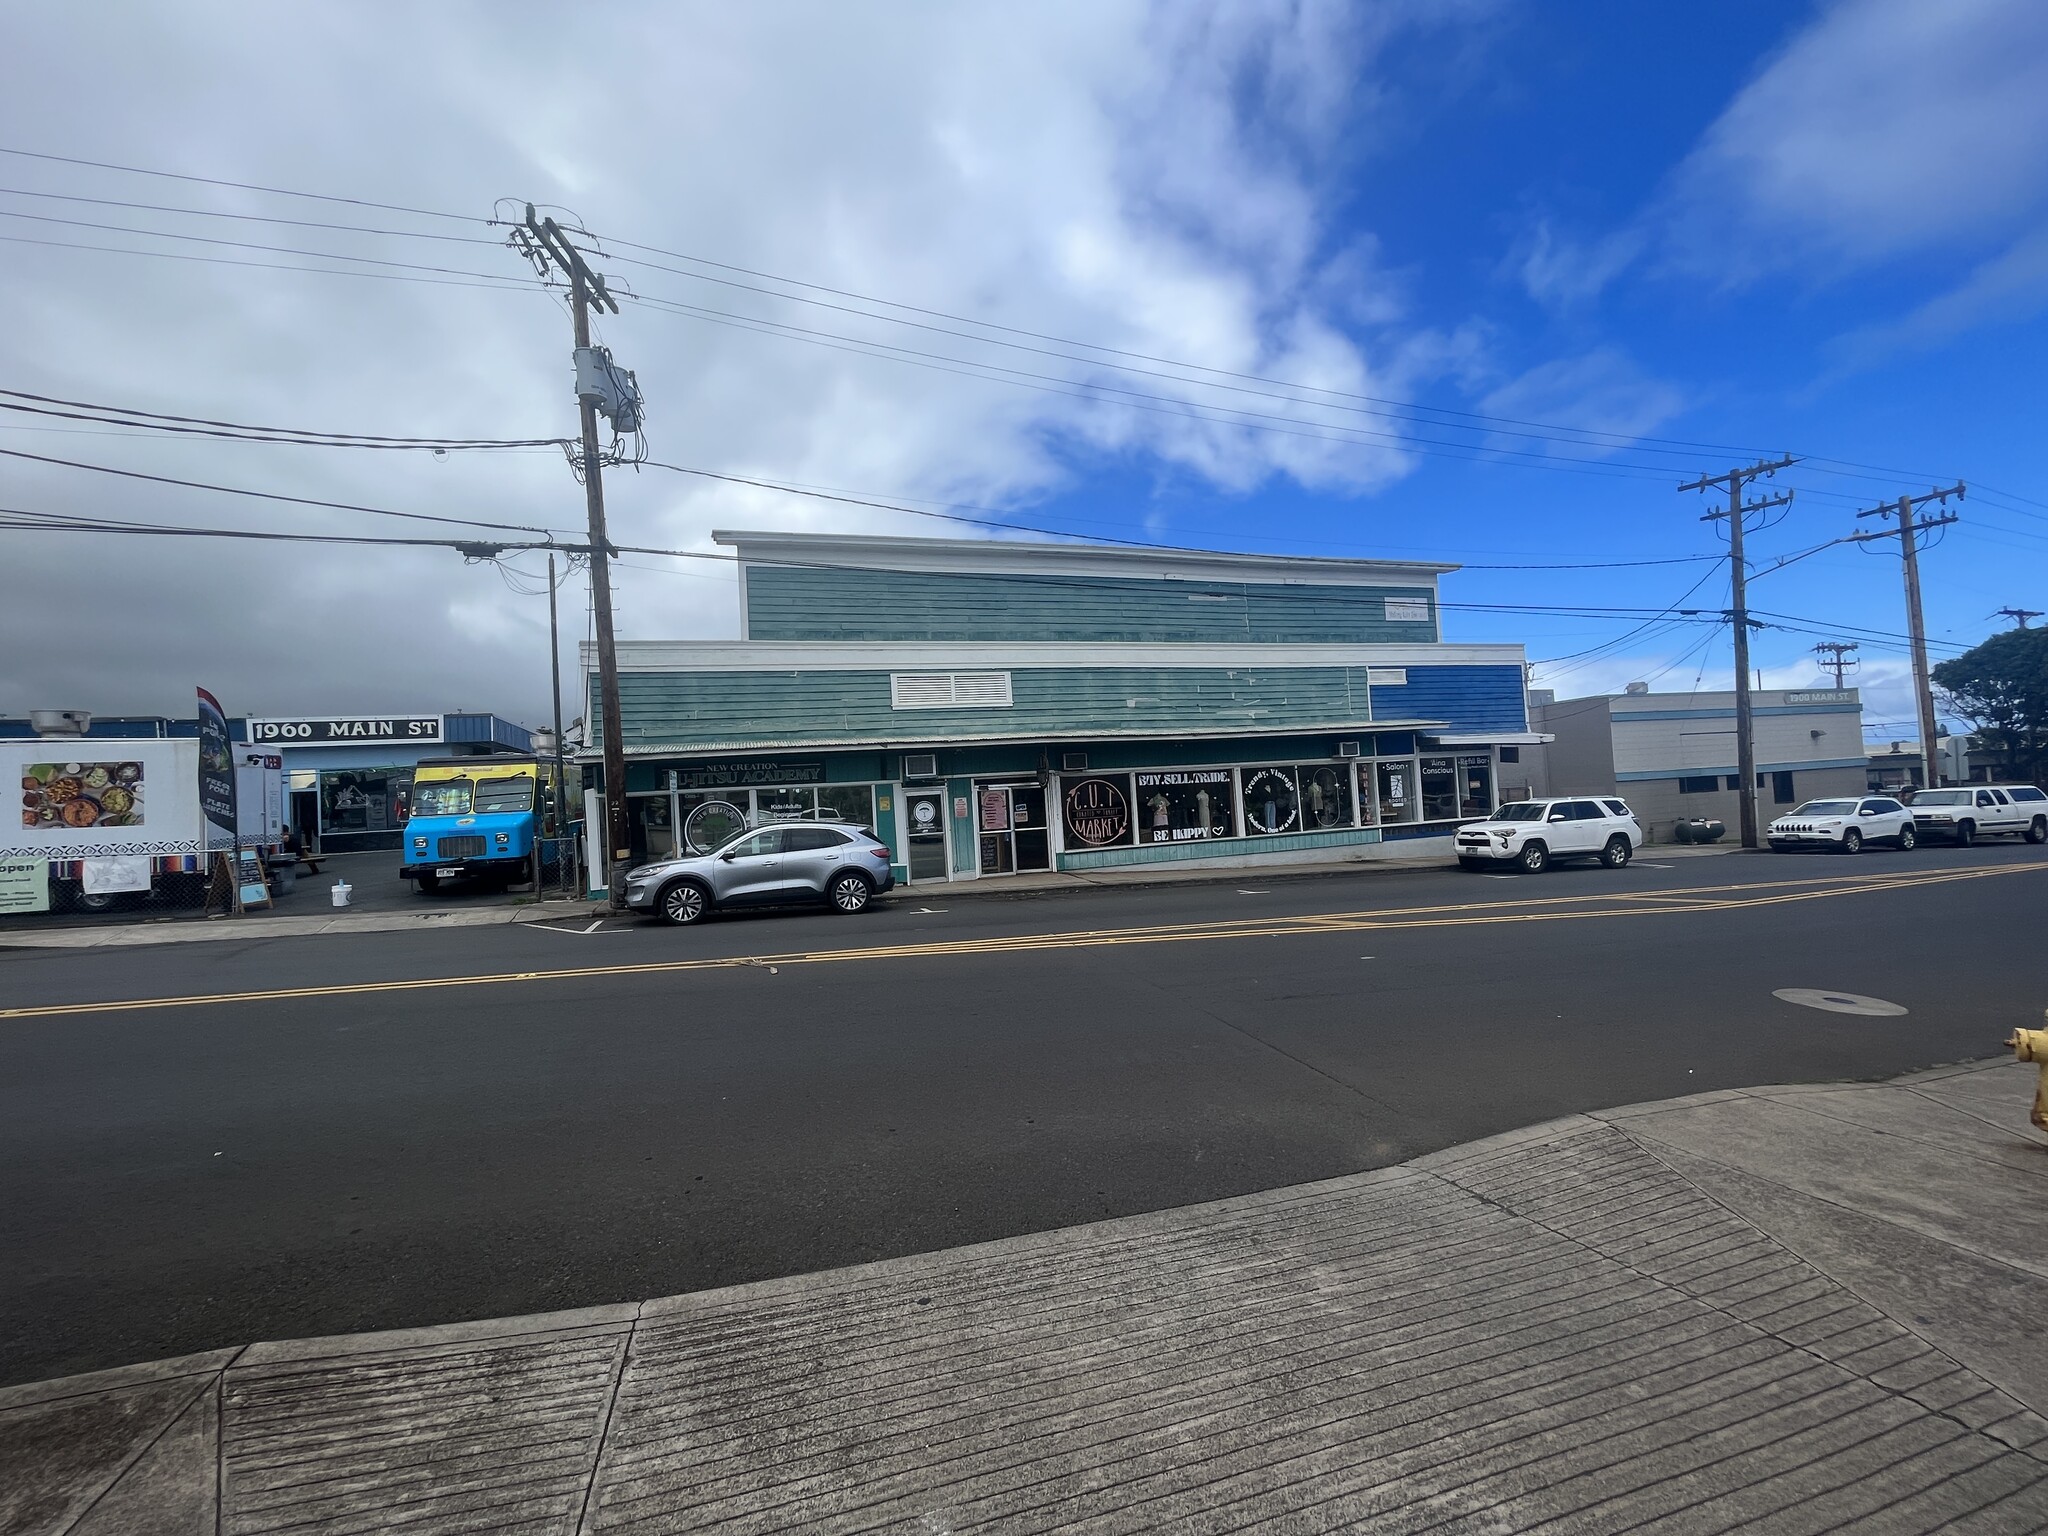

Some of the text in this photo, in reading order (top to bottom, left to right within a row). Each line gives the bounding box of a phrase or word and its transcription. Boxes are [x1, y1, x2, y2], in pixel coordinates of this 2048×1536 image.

[1789, 693, 1810, 702] 1900
[1812, 693, 1836, 701] MAIN
[255, 721, 437, 738] 1960 MAIN ST
[1386, 763, 1405, 771] Salon
[1460, 757, 1488, 766] Refill Bar
[706, 762, 778, 773] NEW CREATION
[1422, 766, 1454, 775] Conscious
[741, 767, 821, 784] ACADEMY
[1270, 768, 1295, 792] Vintage
[1075, 817, 1119, 842] MARKET
[1278, 824, 1285, 832] of
[1153, 829, 1169, 842] BE
